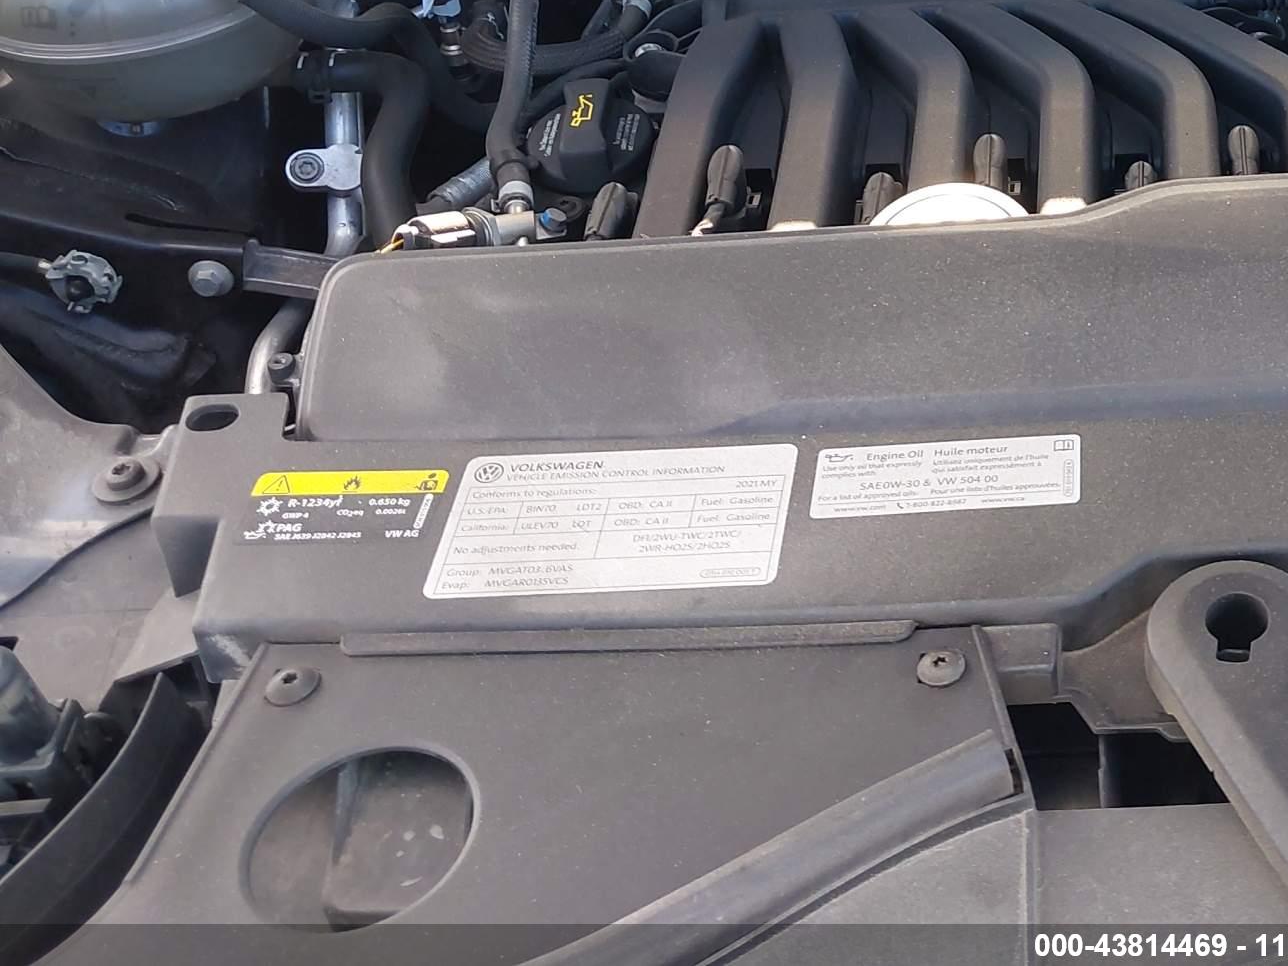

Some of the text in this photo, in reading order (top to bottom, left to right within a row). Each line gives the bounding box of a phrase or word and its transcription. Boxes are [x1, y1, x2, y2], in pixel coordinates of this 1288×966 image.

[866, 449, 924, 463] Engine Oil
[934, 445, 1009, 457] Huile moteur
[510, 461, 604, 473] VOLKSWAGEN
[838, 464, 855, 472] only
[507, 465, 726, 482] VEHICLE EMISSION CONTROL INFORMATION
[936, 474, 999, 486] VW 504 00
[472, 489, 521, 499] Conforms
[523, 488, 535, 497] to
[287, 494, 411, 508] R-1234yf 0.650 kg
[648, 500, 666, 509] CA
[728, 496, 774, 506] Gasoline
[645, 517, 662, 526] CA
[726, 511, 770, 521] Gasoline
[276, 522, 303, 532] PAG
[384, 528, 420, 539] VW AG
[453, 545, 468, 555] No
[470, 543, 536, 556] adjustments
